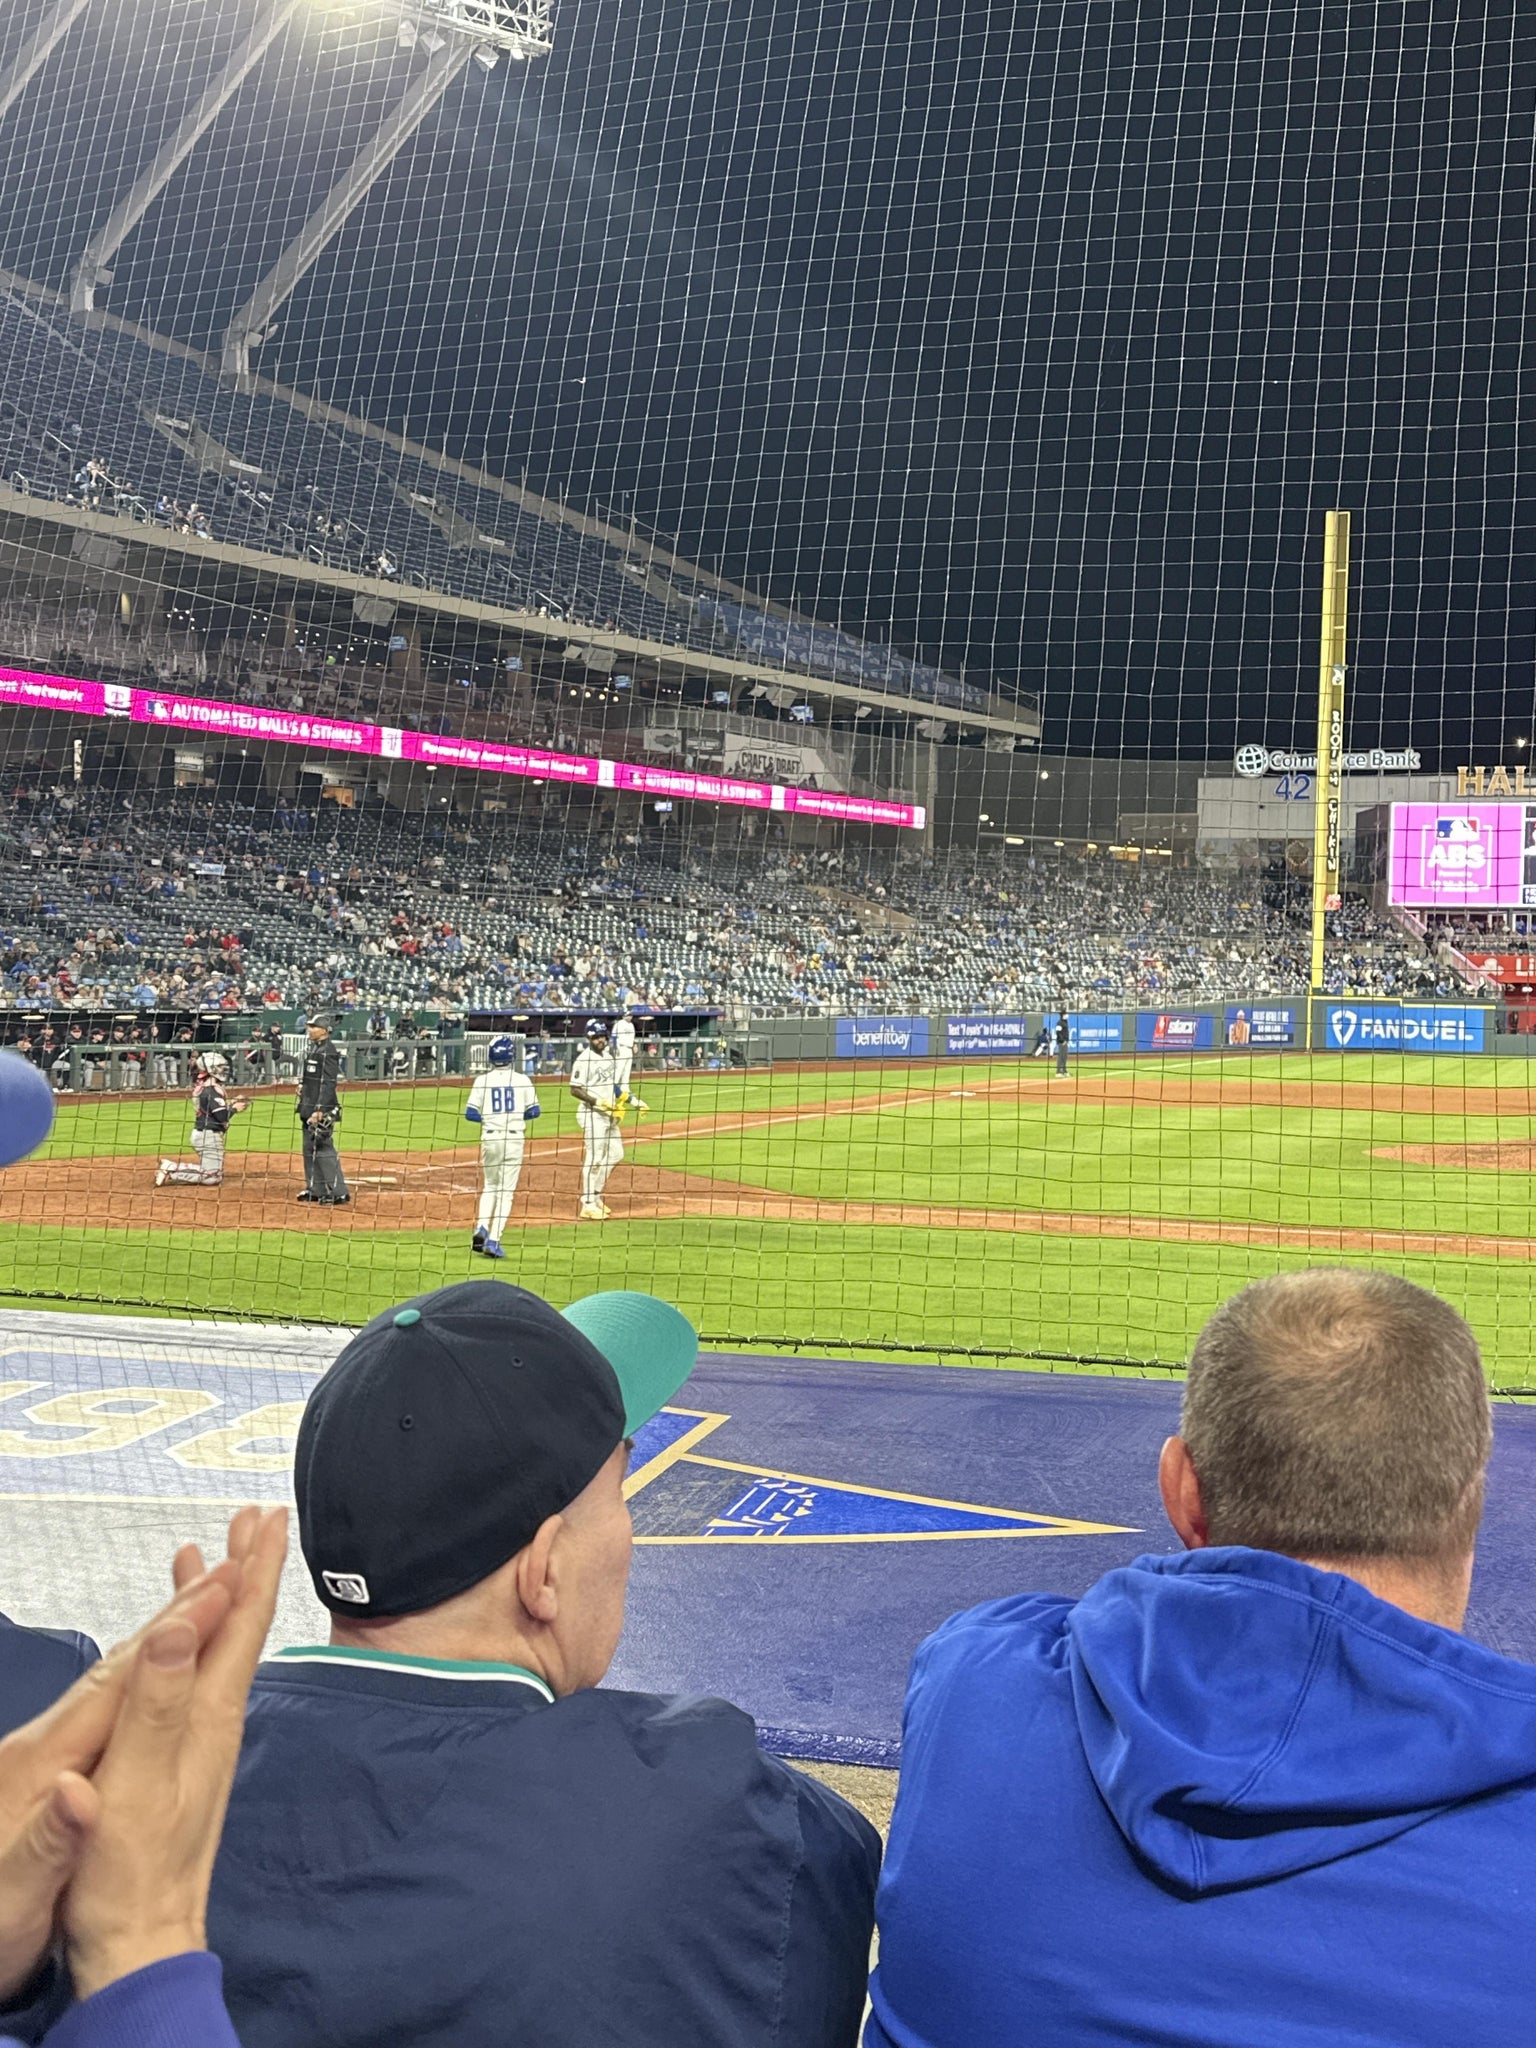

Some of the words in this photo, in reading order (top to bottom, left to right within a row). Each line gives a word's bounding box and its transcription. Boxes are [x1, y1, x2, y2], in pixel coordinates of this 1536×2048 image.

[172, 703, 257, 729] AUTOMATED
[259, 716, 298, 737] BALLS
[300, 721, 310, 737] &
[312, 724, 363, 745] STRIKES
[741, 752, 767, 769] CRAFT
[776, 758, 801, 774] DRAFT
[1270, 752, 1366, 768] Commce
[1372, 749, 1418, 768] Bank
[1275, 773, 1311, 801] 42
[1427, 844, 1486, 868] ABS
[853, 1024, 912, 1050] benefitbay
[1361, 1018, 1474, 1041] FANDUEL
